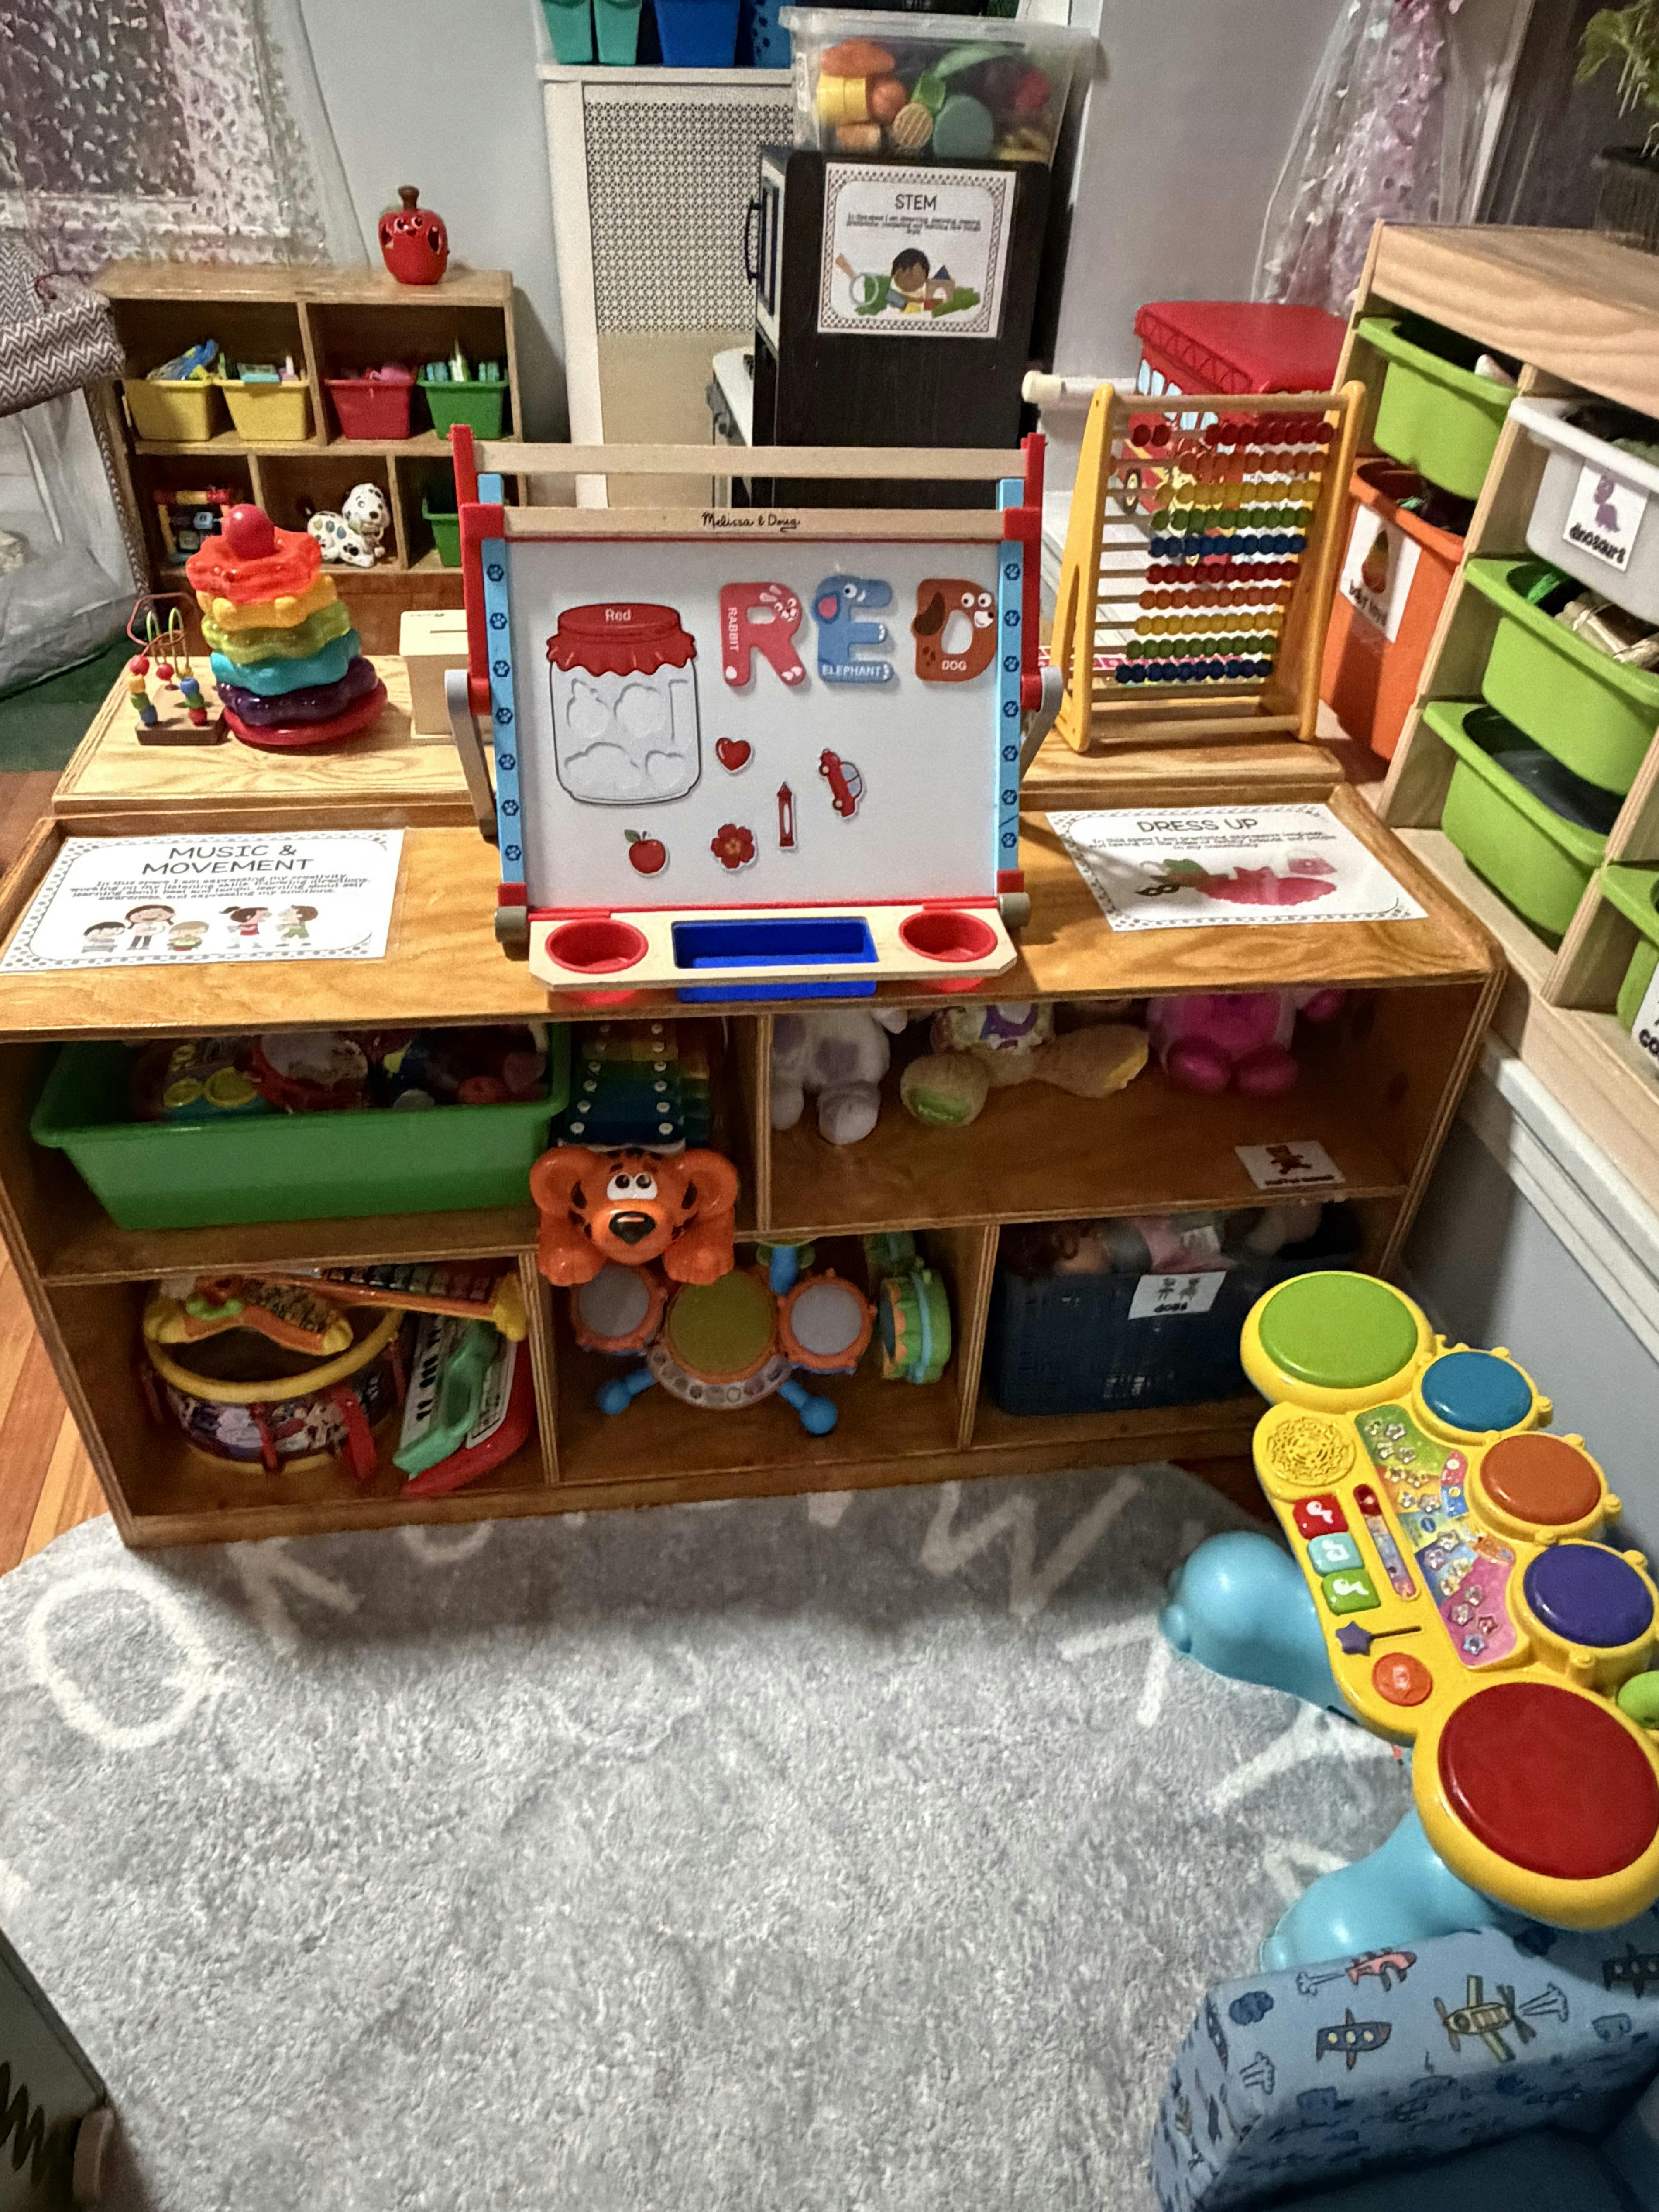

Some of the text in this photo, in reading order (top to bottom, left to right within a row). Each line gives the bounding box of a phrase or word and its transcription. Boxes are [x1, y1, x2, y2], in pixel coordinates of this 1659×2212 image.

[895, 193, 937, 211] STEM
[702, 511, 754, 529] Melissa
[768, 513, 800, 532] Doug
[605, 608, 631, 622] Red
[728, 606, 739, 653] RABBIT
[822, 665, 881, 677] ELEPHANT
[941, 660, 967, 671] DOG
[1137, 818, 1258, 833] DRESS UP
[169, 844, 297, 859] MUSIC &
[142, 858, 314, 874] MOVEMENT
